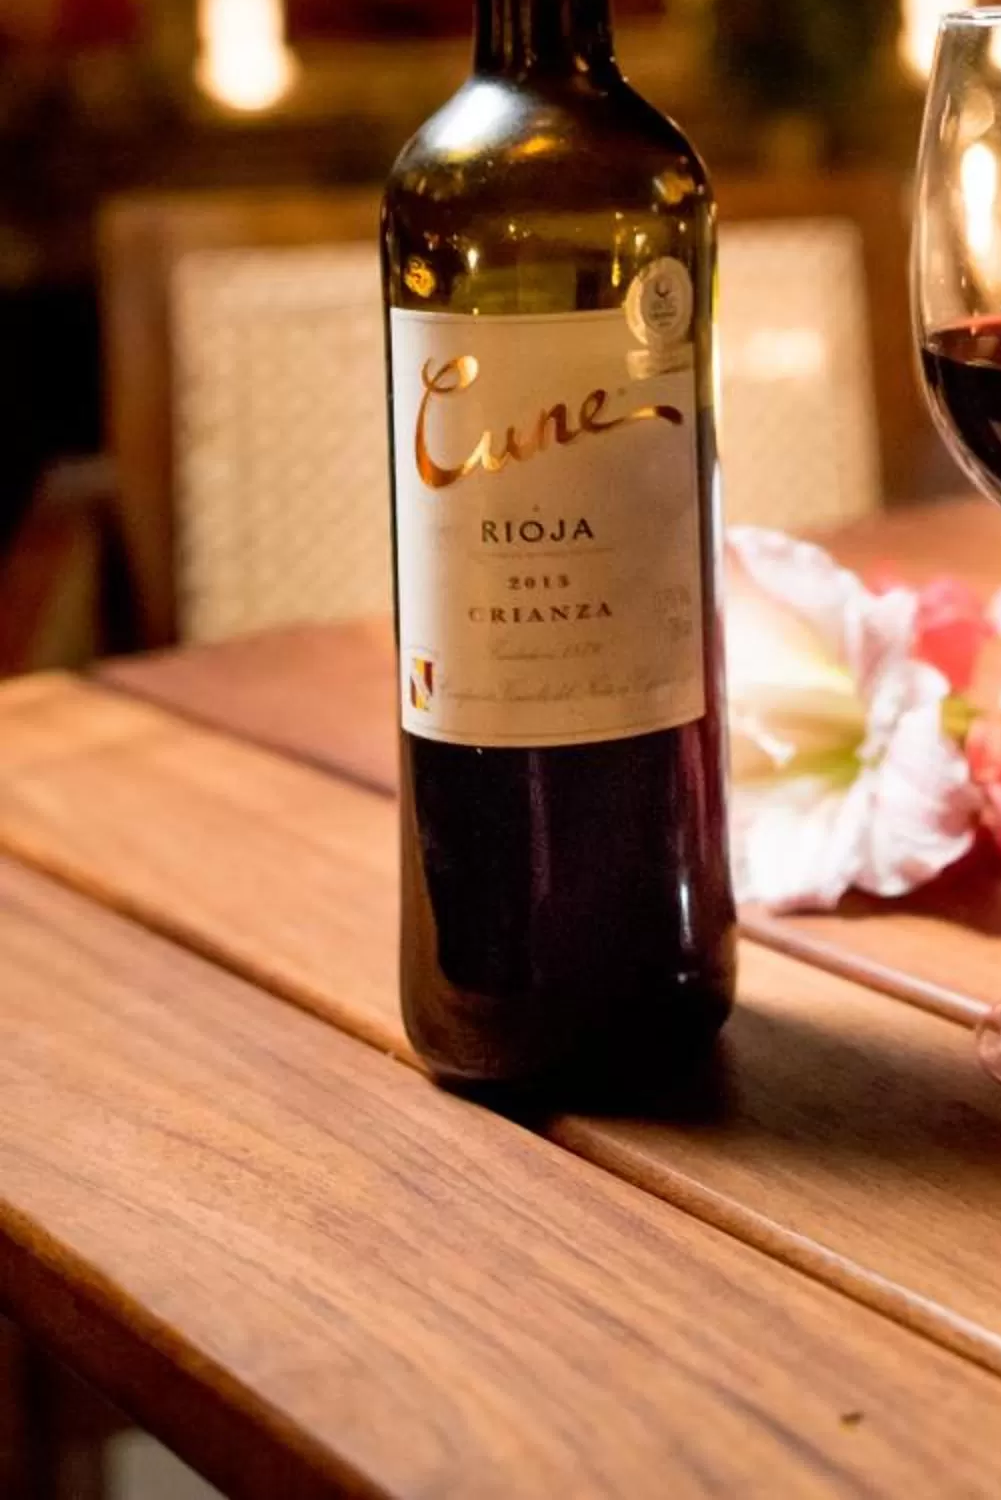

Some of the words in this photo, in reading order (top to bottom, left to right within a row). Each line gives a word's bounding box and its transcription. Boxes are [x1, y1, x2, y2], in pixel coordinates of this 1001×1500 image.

[415, 355, 684, 489] Cune
[481, 518, 595, 543] RIOJA
[468, 601, 613, 624] CRIANZA
